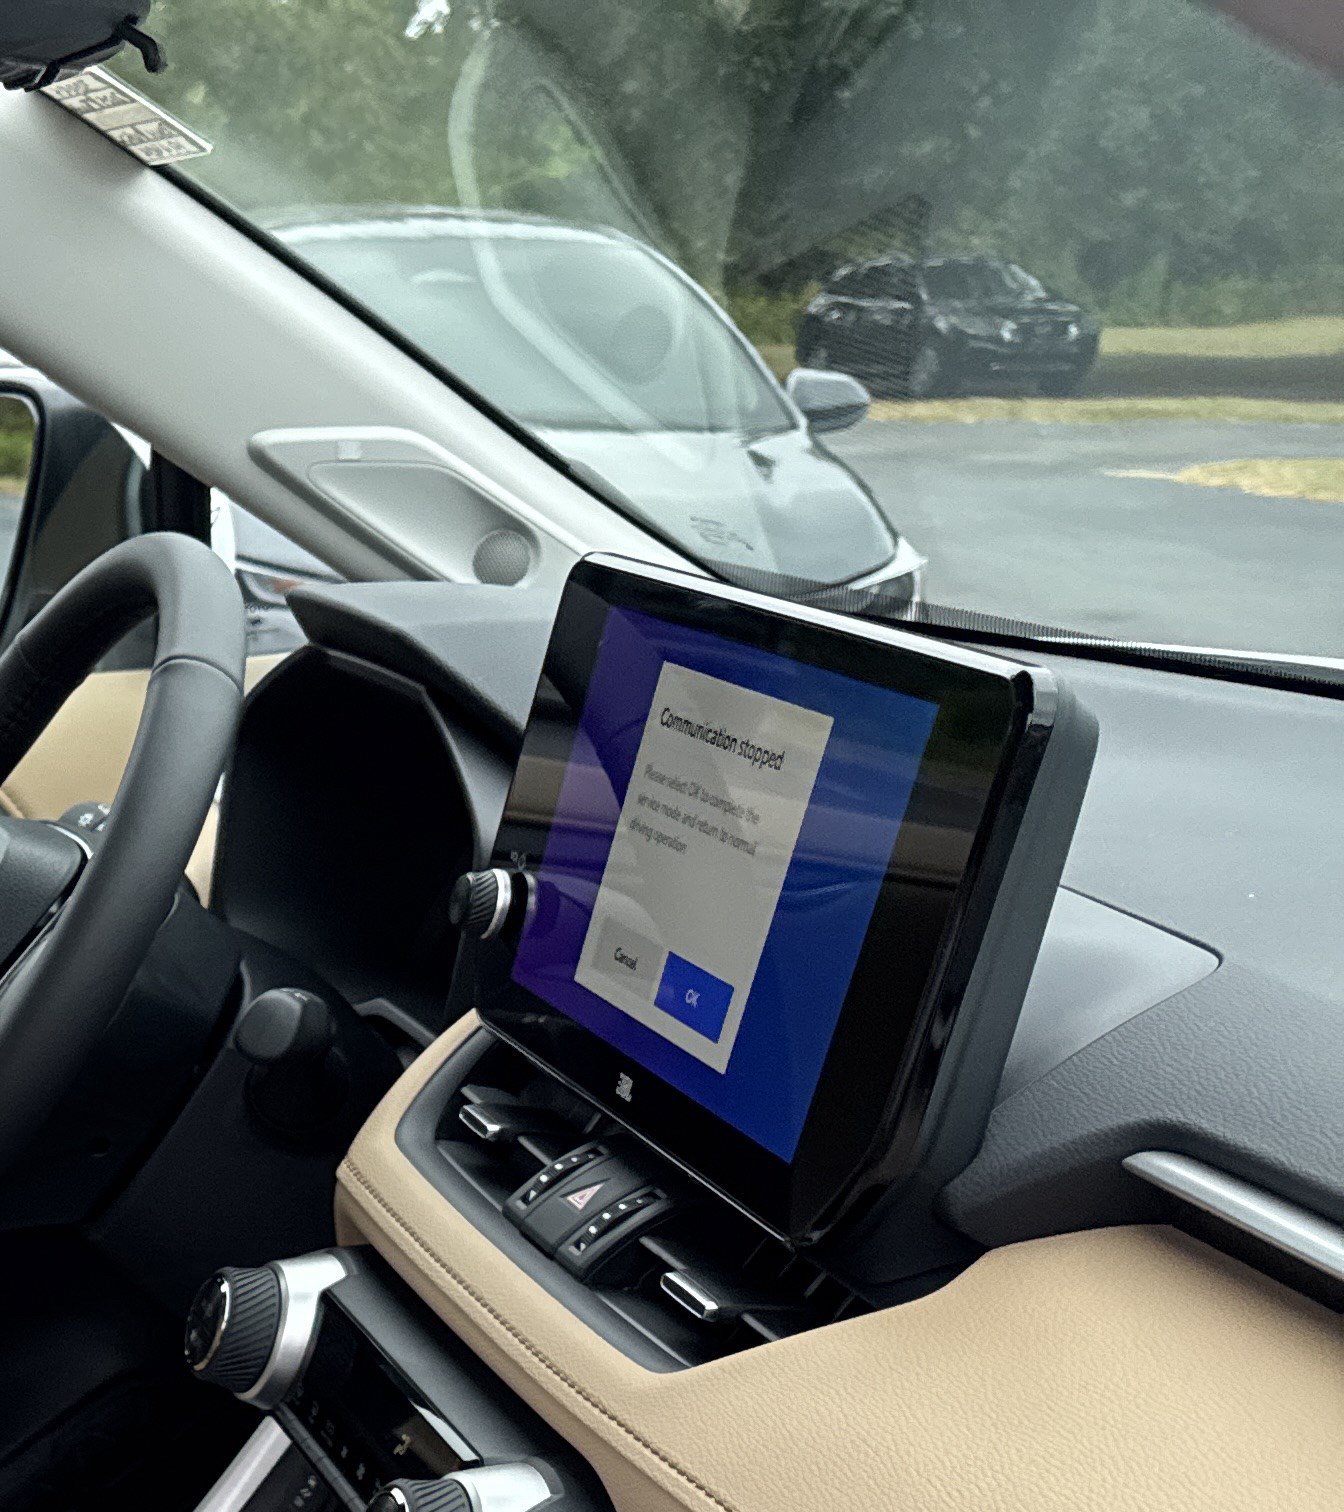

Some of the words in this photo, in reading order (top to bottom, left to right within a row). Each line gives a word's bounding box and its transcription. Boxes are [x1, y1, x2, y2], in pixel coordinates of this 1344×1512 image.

[660, 706, 737, 753] Communication
[738, 736, 785, 771] stopped
[614, 947, 638, 971] Cancel
